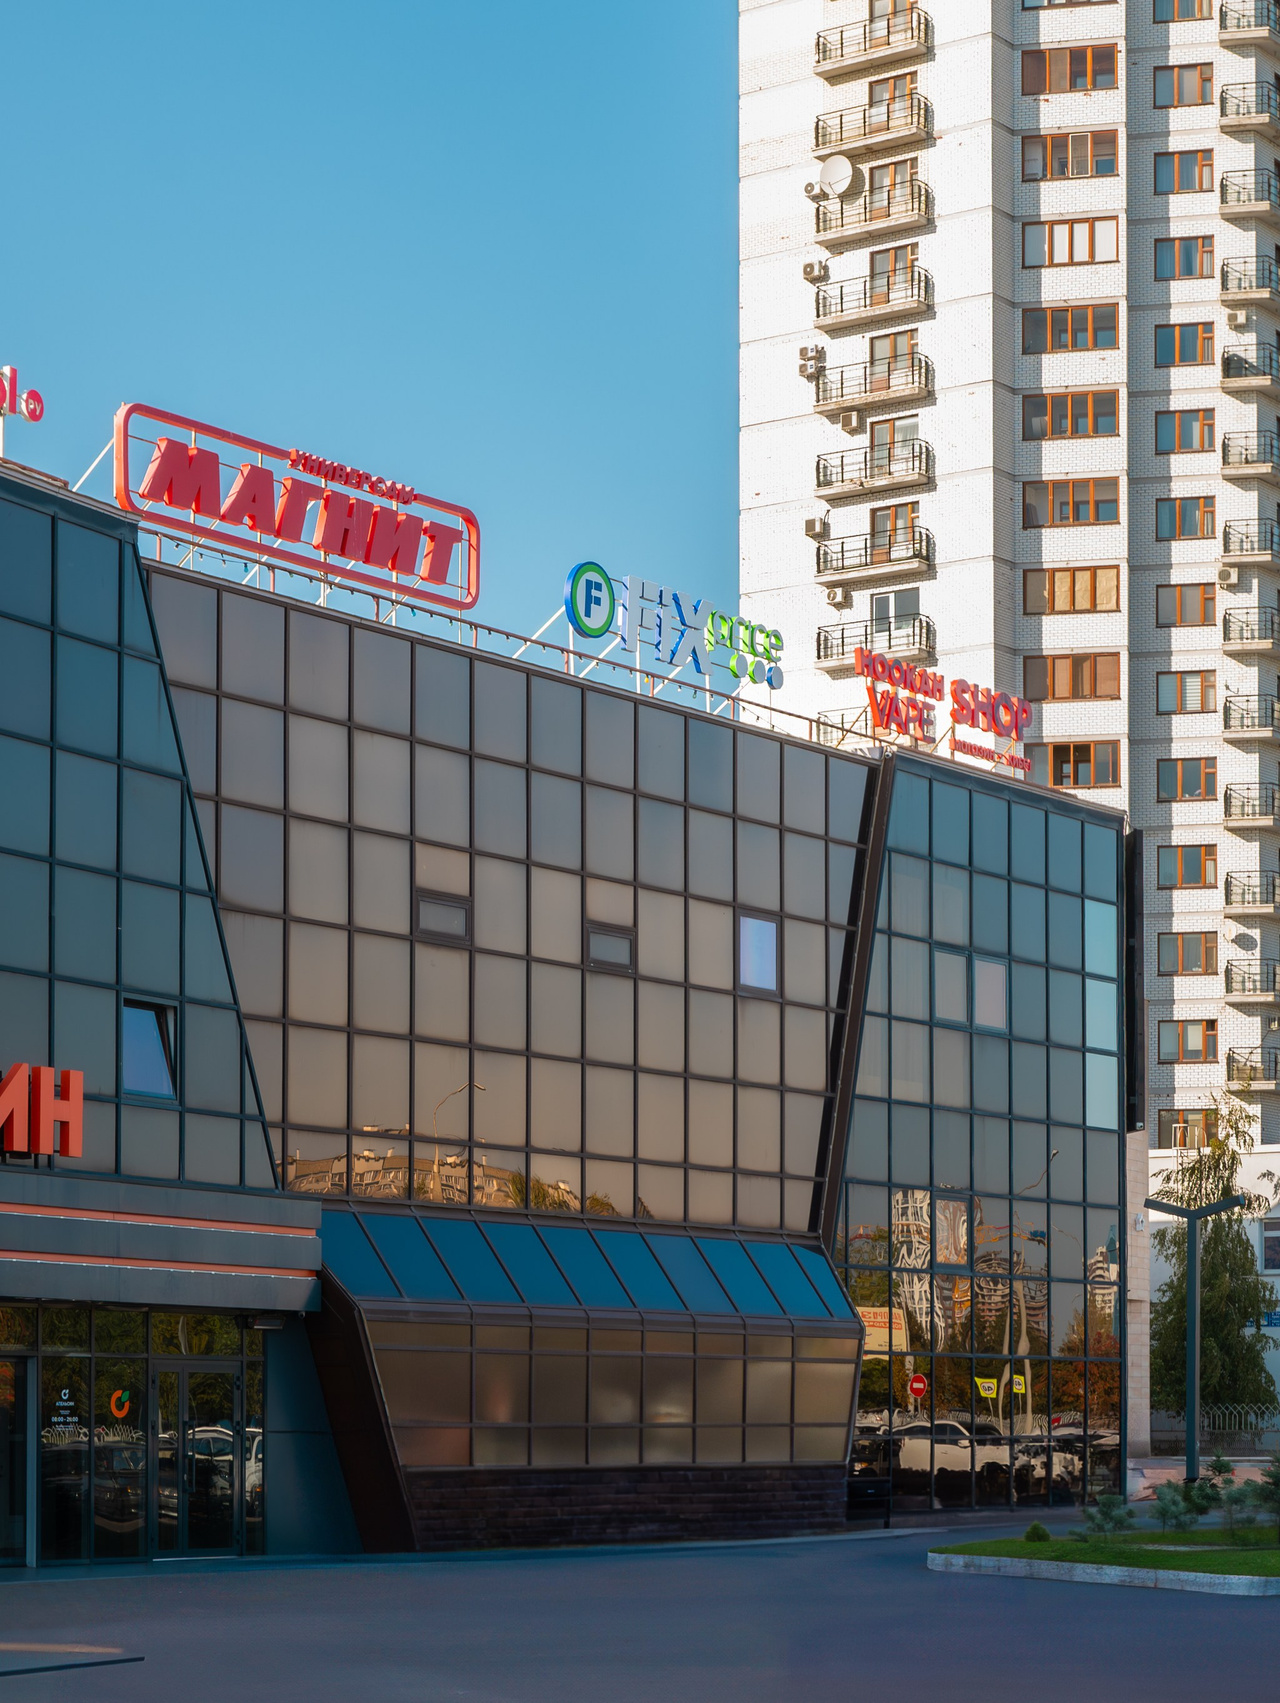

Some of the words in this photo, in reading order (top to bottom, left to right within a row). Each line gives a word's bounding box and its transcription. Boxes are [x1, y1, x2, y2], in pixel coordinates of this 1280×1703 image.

[288, 448, 415, 506] УНИВЕРСАМ
[138, 437, 464, 586] МАГНИТ
[706, 610, 784, 663] price
[854, 646, 945, 701] HOOKAH
[950, 678, 1033, 741] SHOP
[866, 685, 936, 744] VAPE
